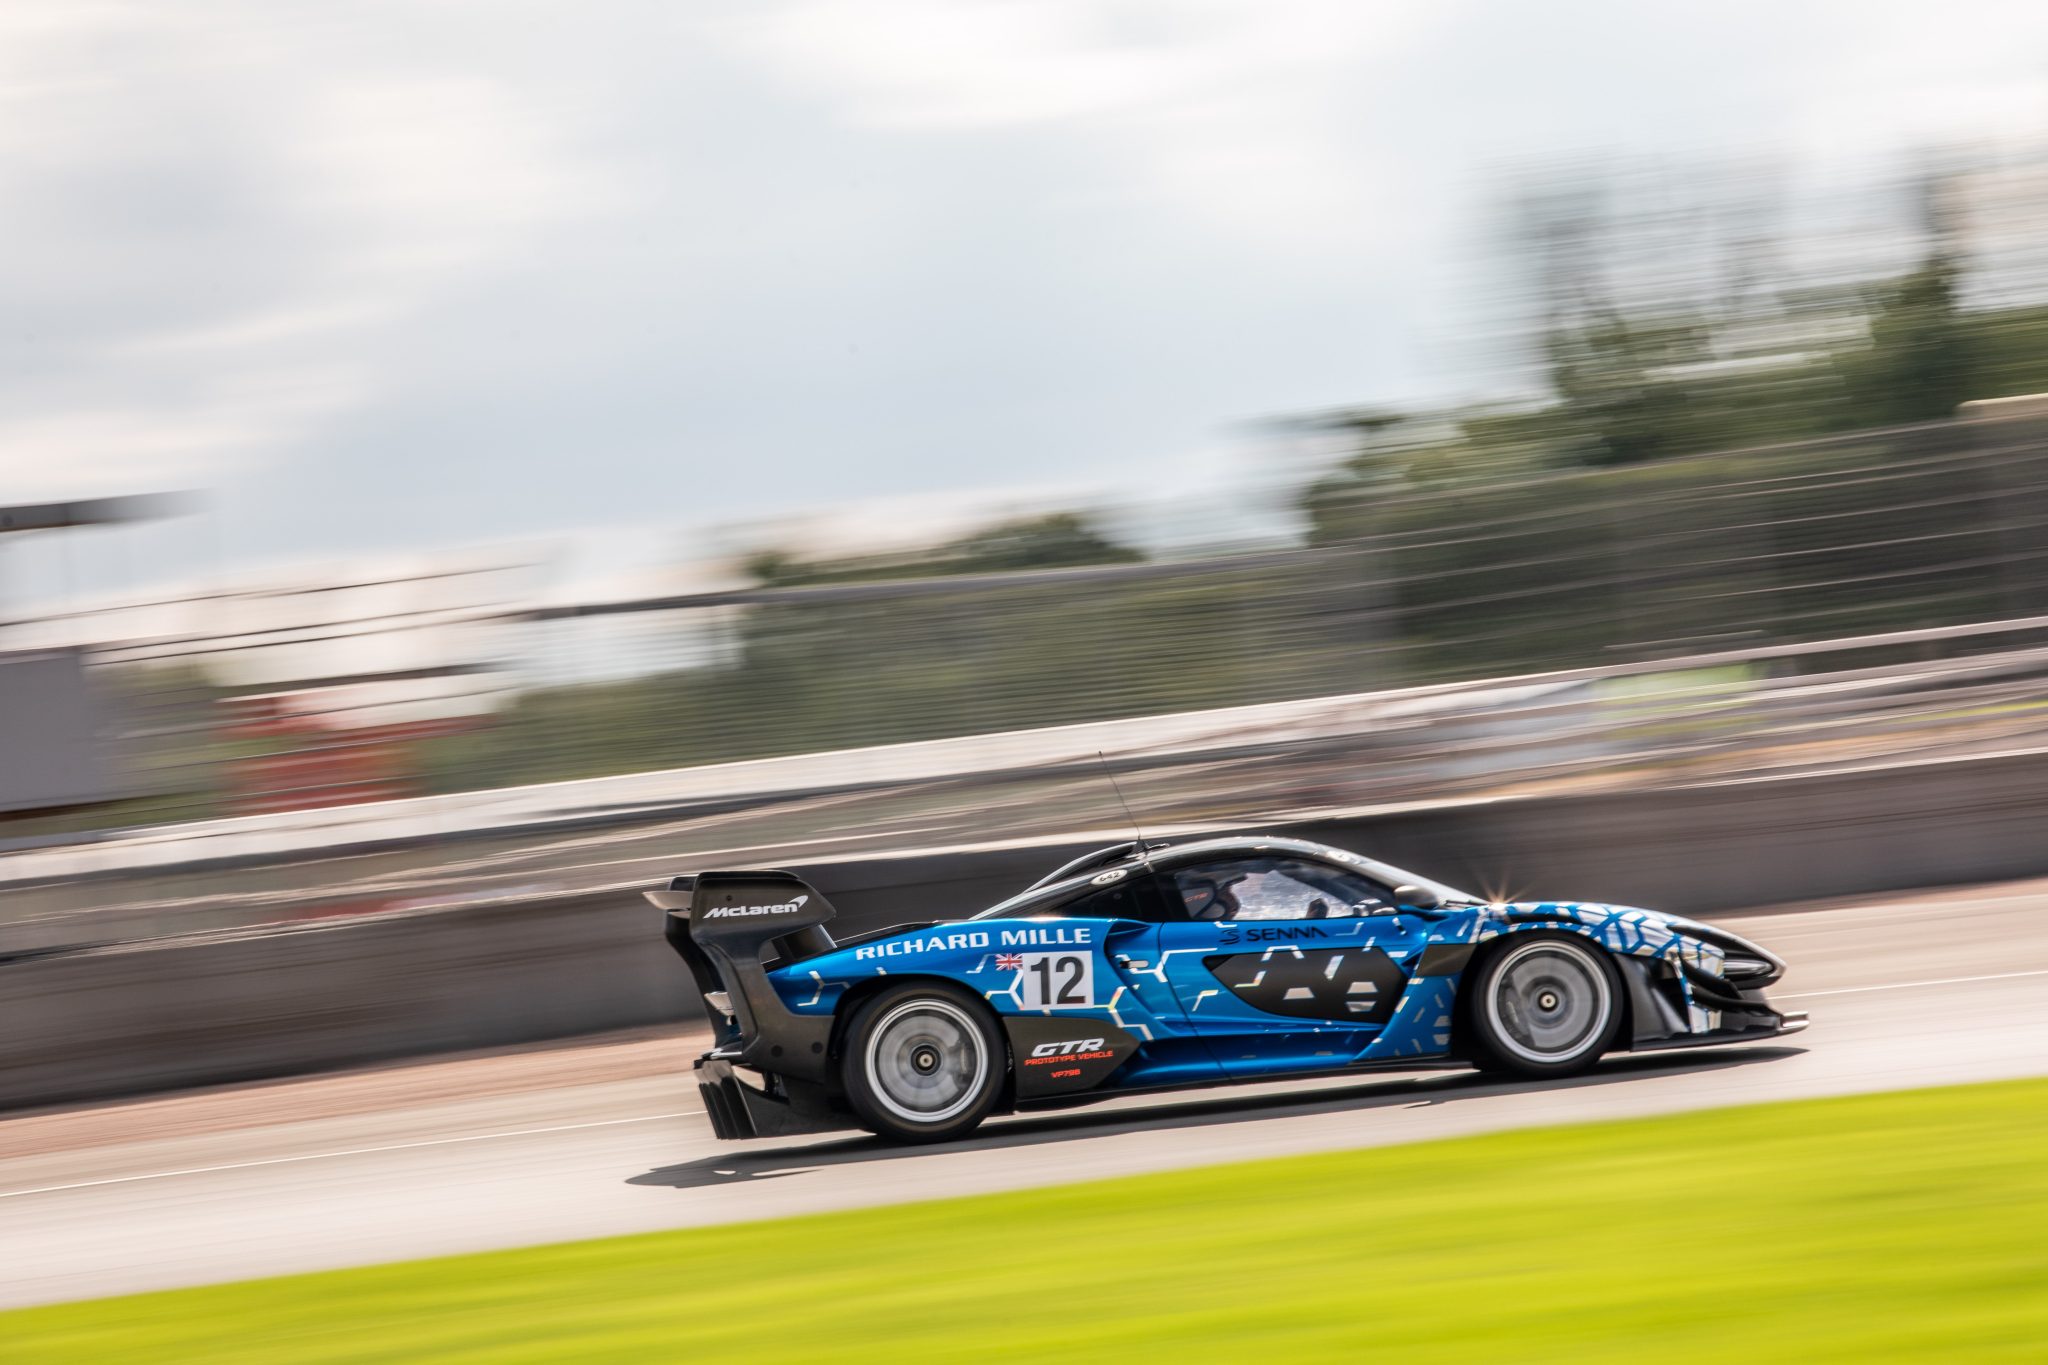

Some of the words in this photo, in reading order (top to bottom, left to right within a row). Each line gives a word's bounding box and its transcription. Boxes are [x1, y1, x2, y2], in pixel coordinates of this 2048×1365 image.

[703, 903, 798, 919] McLaren
[1246, 926, 1328, 942] SENNA
[856, 932, 989, 960] RICHARD
[1001, 928, 1092, 946] MILLE
[1030, 956, 1087, 1006] 12
[1031, 1038, 1104, 1057] GTR
[1024, 1054, 1077, 1066] PROTOTYPE
[1078, 1050, 1114, 1060] VEHICLE
